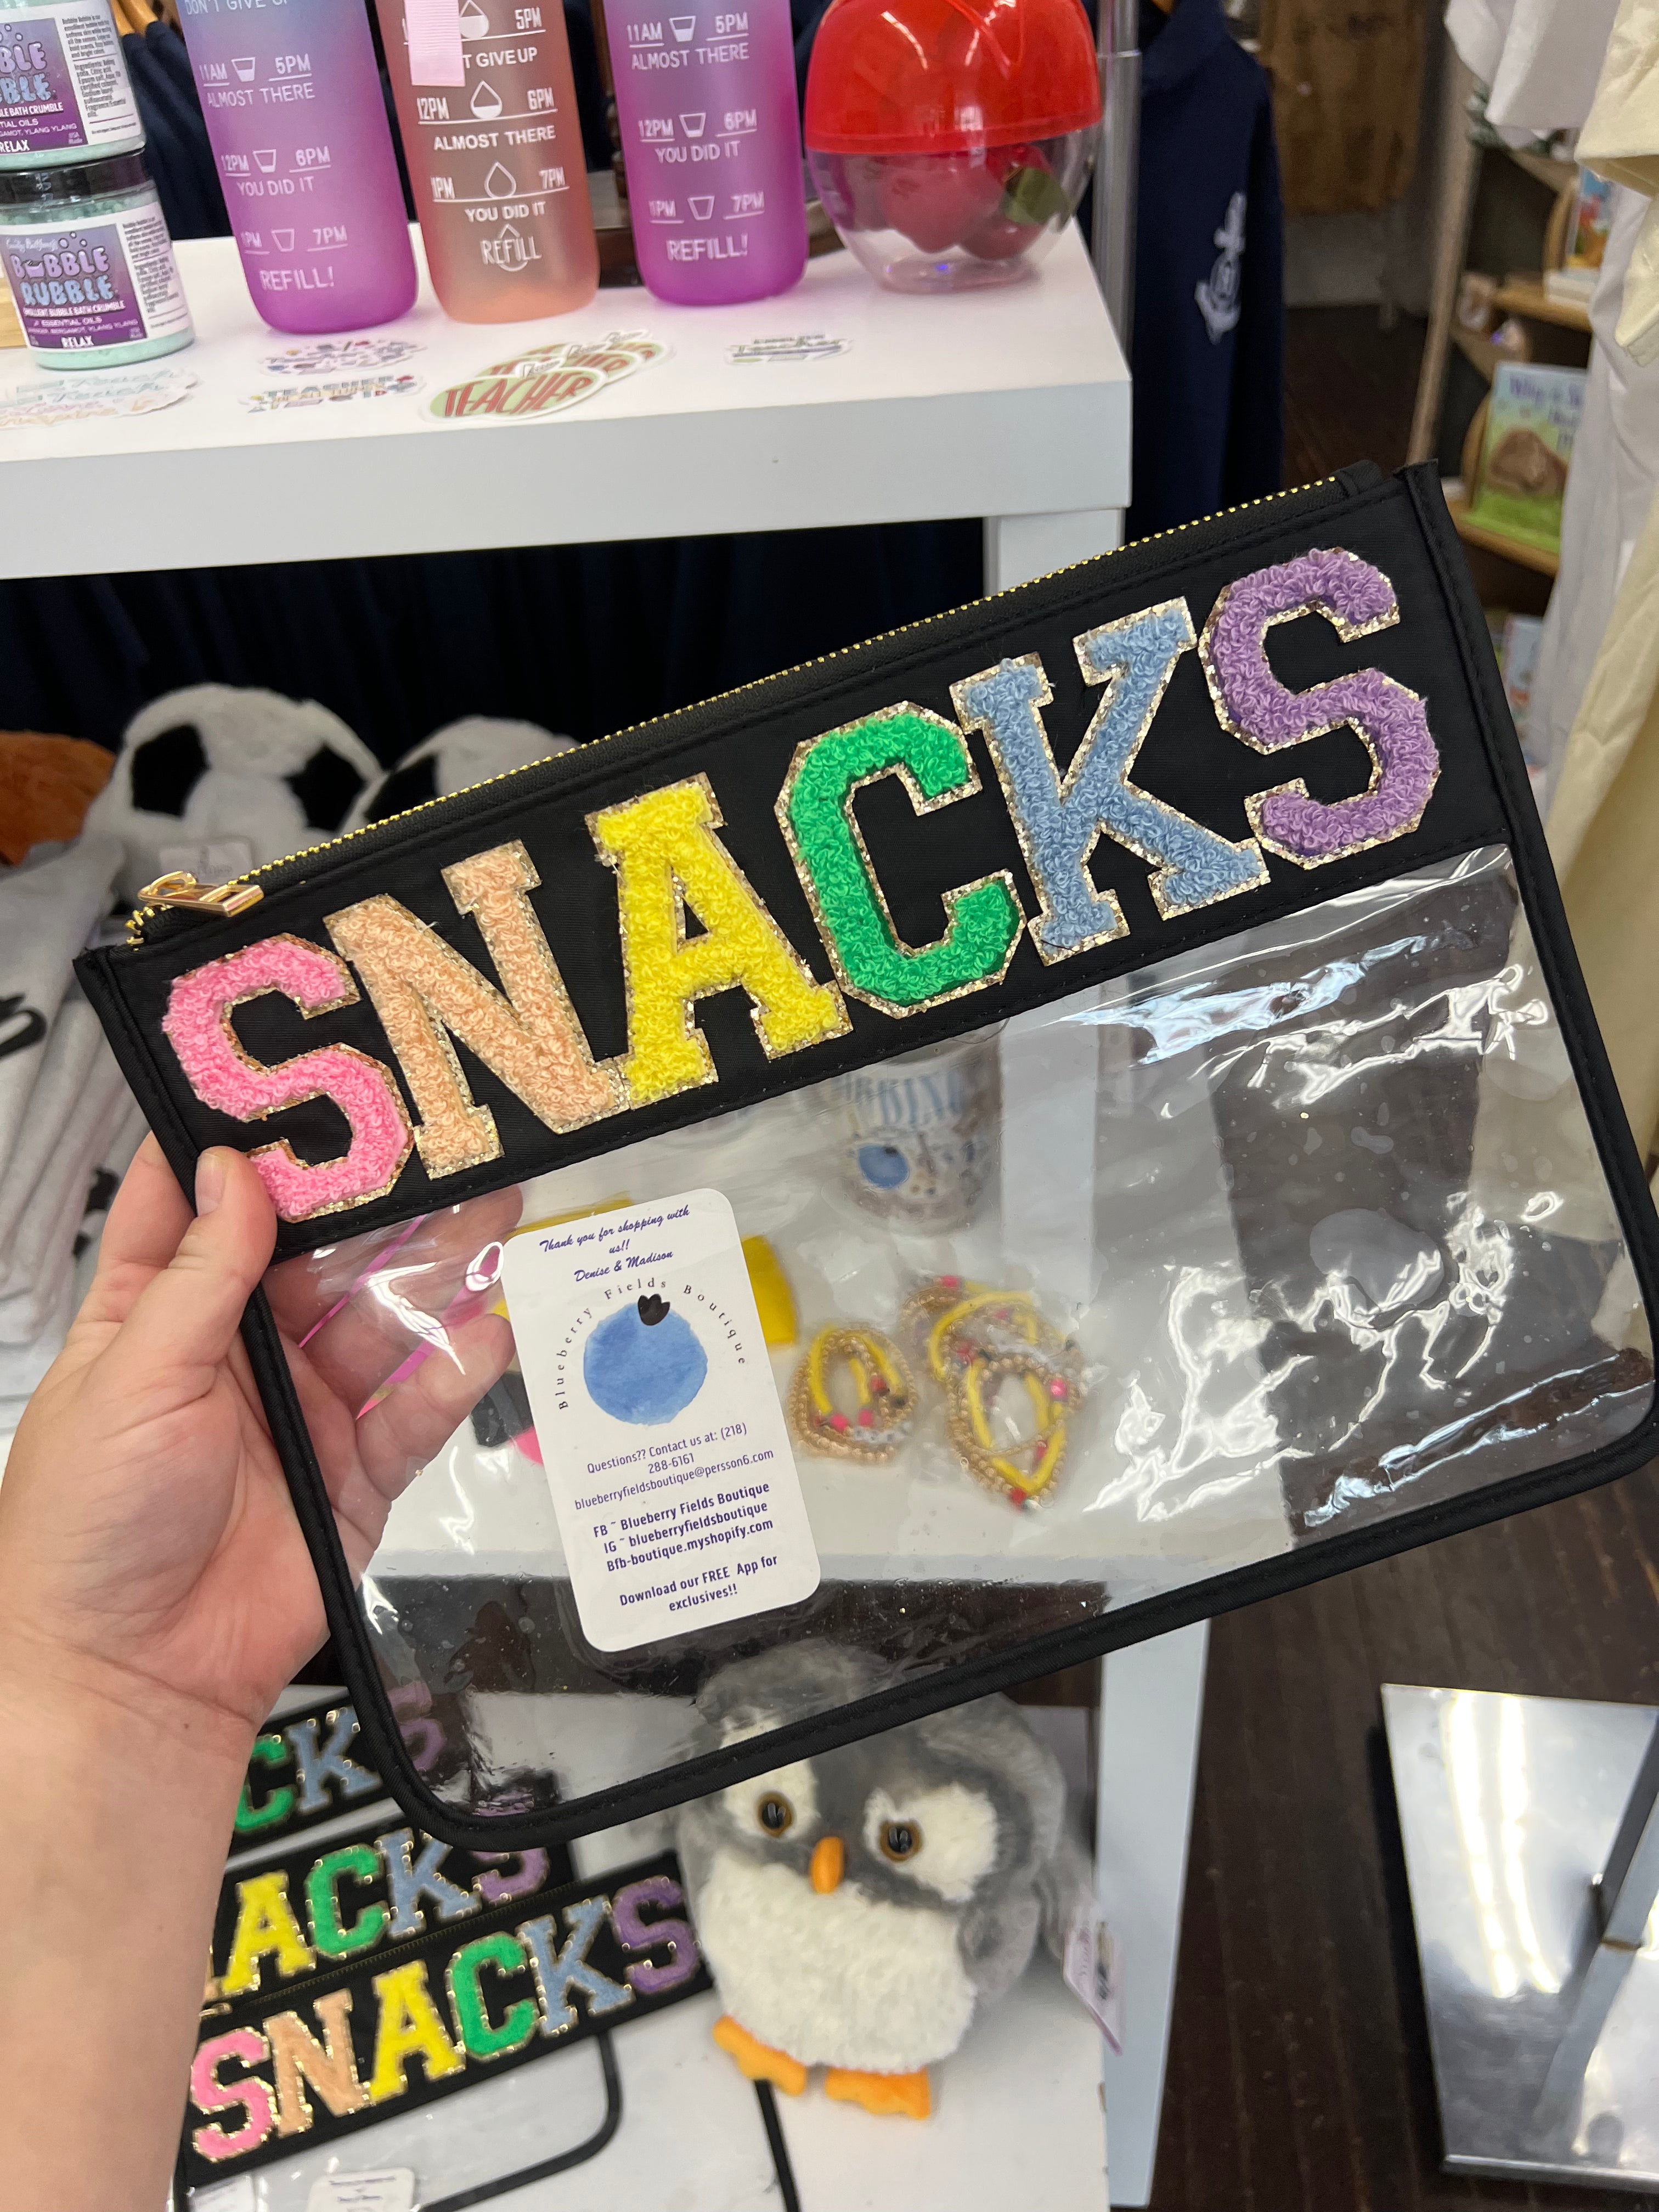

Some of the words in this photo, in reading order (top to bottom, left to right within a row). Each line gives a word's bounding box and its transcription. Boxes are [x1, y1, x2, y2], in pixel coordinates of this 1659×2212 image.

[515, 7, 542, 30] 5PM
[627, 21, 663, 42] 11AM
[715, 12, 748, 33] 5PM
[199, 63, 228, 80] 11AM
[275, 53, 311, 74] 5PM
[476, 49, 516, 67] GIVE
[517, 47, 538, 63] UP
[631, 50, 690, 70] ALMOST
[695, 42, 750, 65] THERE
[9, 106, 29, 116] BATH
[29, 102, 64, 115] CRUMBLE
[206, 89, 254, 108] ALMOST
[259, 82, 316, 104] THERE
[417, 97, 450, 120] 12PM
[527, 87, 554, 110] 6PM
[19, 118, 39, 127] OILS
[638, 119, 674, 137] 12PM
[724, 109, 757, 131] 6PM
[433, 132, 499, 150] ALMOST
[504, 125, 556, 145] THERE
[654, 146, 687, 163] YOU
[691, 143, 720, 162] DID
[724, 140, 740, 159] IT
[221, 154, 249, 171] 12PM
[296, 145, 331, 166] 6PM
[236, 180, 264, 196] YOU
[267, 179, 295, 195] DID
[300, 176, 314, 191] IT
[430, 176, 455, 199] 1PM
[538, 166, 566, 190] 7PM
[465, 206, 498, 223] YOU
[502, 204, 529, 219] DID
[532, 201, 546, 216] IT
[648, 199, 676, 217] 1PM
[731, 190, 765, 212] 7PM
[312, 225, 347, 245] 7PM
[666, 233, 748, 262] REFILL!
[479, 236, 542, 266] REFILL
[20, 274, 114, 306] RUBBLE
[259, 266, 335, 291] REFILL!
[61, 335, 95, 348] RELAX
[444, 371, 593, 417] TEACHER
[162, 545, 1442, 1223] SNACKS
[539, 1234, 574, 1252] Thank
[577, 1233, 596, 1246] you
[599, 1227, 615, 1242] for
[618, 1215, 664, 1233] shopping
[667, 1204, 690, 1220] with
[609, 1238, 630, 1254] us!!
[574, 1267, 610, 1282] Denise
[614, 1260, 622, 1272] &
[626, 1251, 674, 1268] Madison
[555, 1308, 592, 1410] Blueberry
[604, 1277, 667, 1300] Fields
[684, 1284, 746, 1364] Boutique
[587, 1449, 646, 1474] Questions??
[649, 1439, 688, 1457] Contact
[690, 1436, 702, 1446] us
[704, 1432, 718, 1443] at:
[720, 1422, 747, 1441] (218)
[647, 1453, 695, 1474] 288-6161
[574, 1450, 774, 1510] blueberryfieldsboutique@persson6.com
[593, 1525, 608, 1538] FB
[620, 1508, 676, 1531] Blueberry
[679, 1497, 715, 1515] Fields
[716, 1483, 770, 1505] Boutique
[603, 1541, 617, 1554] IG
[628, 1503, 768, 1547] blueberryfieldsboutique
[606, 1520, 774, 1572] Bfb-boutique.myshopify.com
[619, 1580, 677, 1606] Download
[680, 1577, 699, 1589] our
[702, 1566, 731, 1584] FREE
[737, 1561, 758, 1576] App
[760, 1555, 777, 1568] for
[669, 1583, 738, 1611] exclusives!!
[190, 1874, 702, 2162] SNACKS
